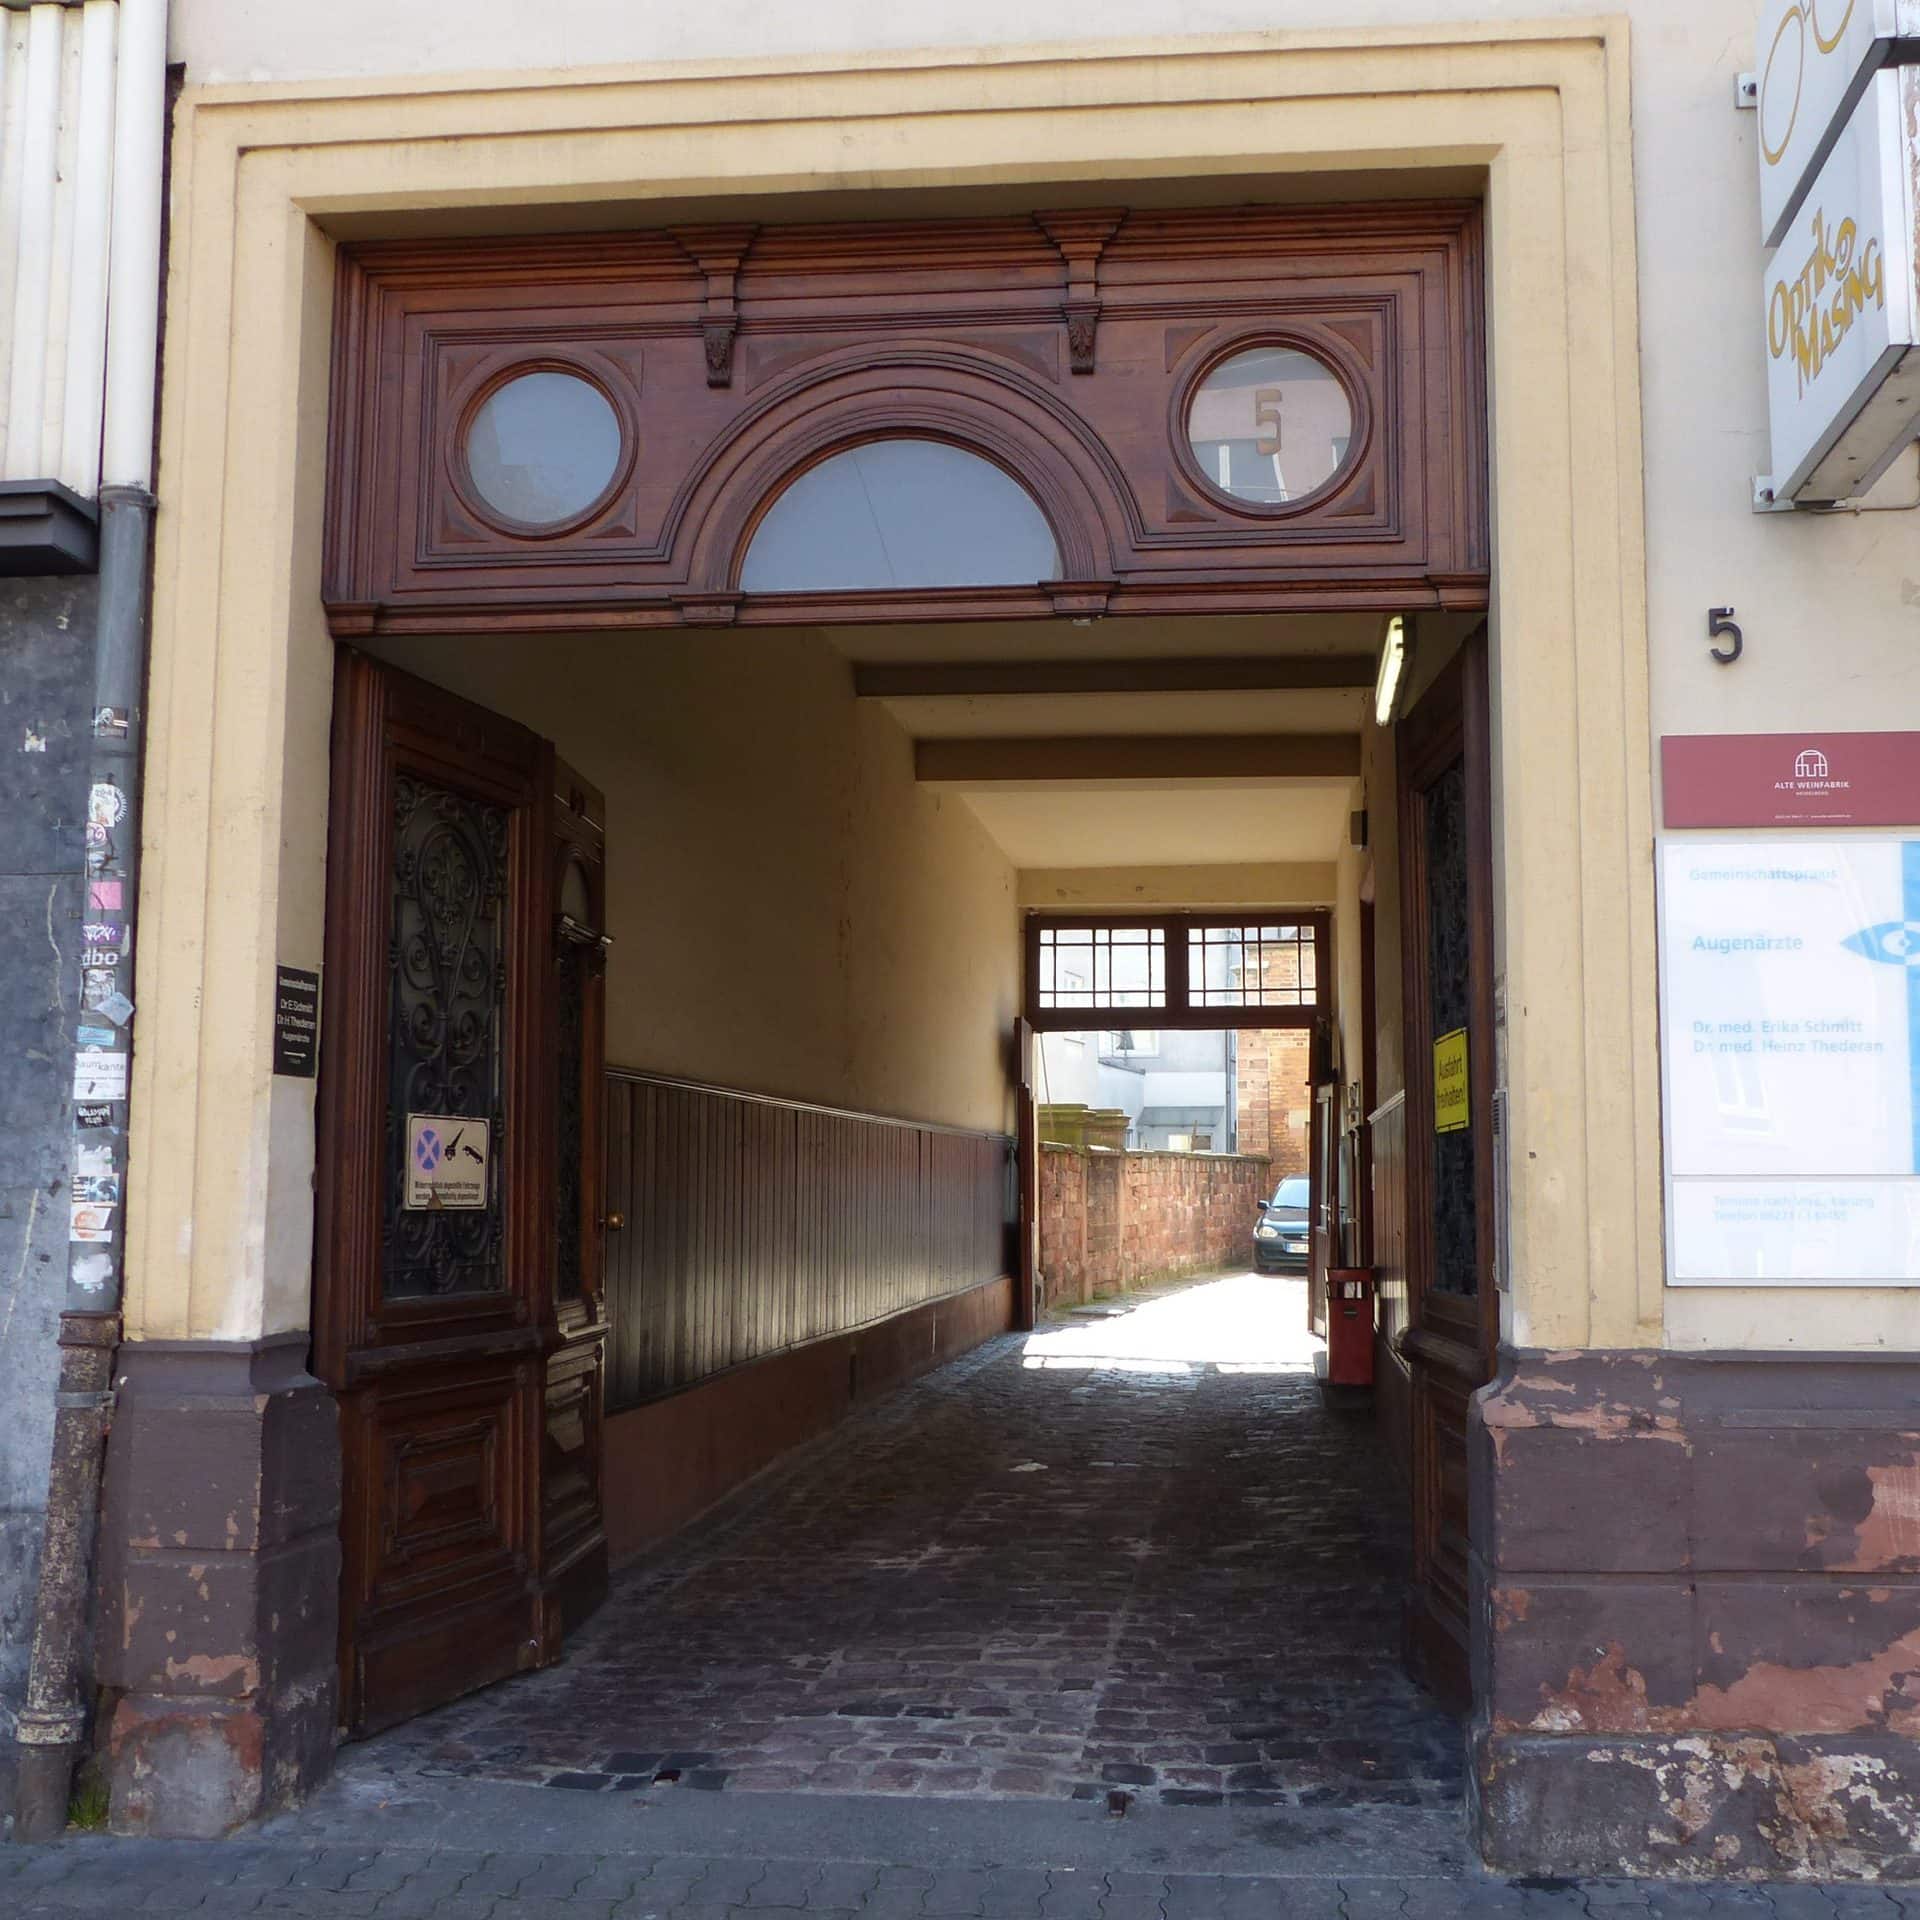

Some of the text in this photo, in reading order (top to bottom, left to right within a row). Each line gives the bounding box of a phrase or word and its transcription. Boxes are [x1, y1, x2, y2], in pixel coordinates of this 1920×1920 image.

[1797, 237, 1884, 401] MASING
[1255, 388, 1283, 456] 5
[1708, 607, 1743, 664] 5
[1774, 780, 1850, 790] ALTE WEINFABRIK
[1693, 934, 1804, 954] Augenärzte
[1760, 1020, 1799, 1033] Erika
[1804, 1019, 1863, 1033] Schmitt
[1812, 1039, 1885, 1053] Thederan
